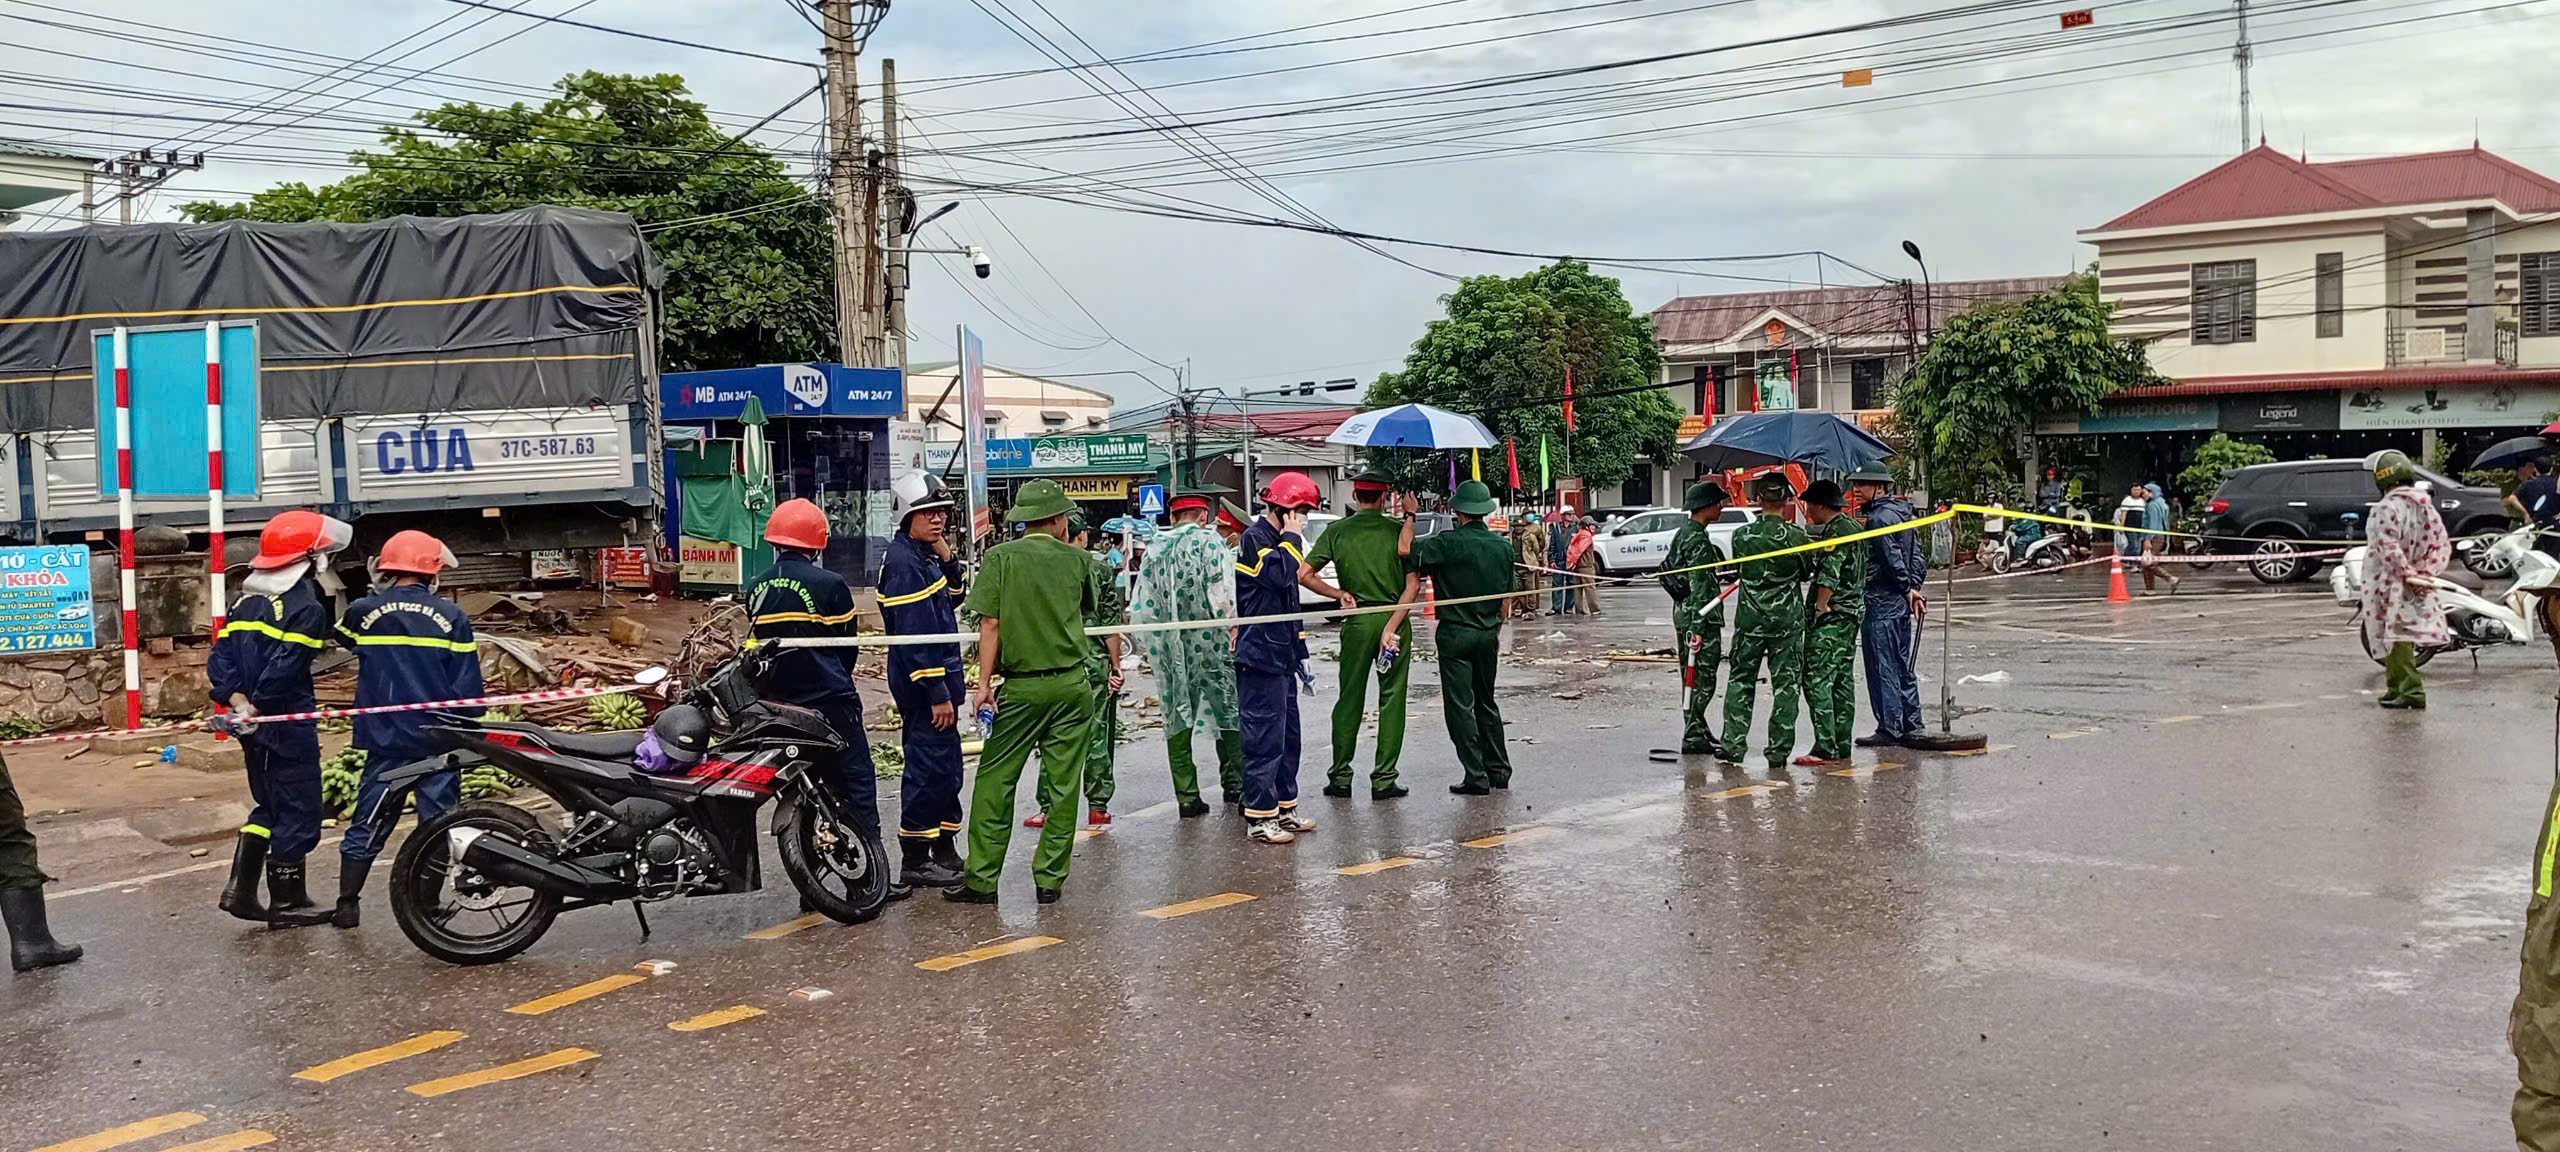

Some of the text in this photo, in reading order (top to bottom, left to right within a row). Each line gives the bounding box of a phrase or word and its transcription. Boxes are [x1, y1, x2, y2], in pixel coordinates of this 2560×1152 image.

[793, 375, 823, 393] ATM
[695, 386, 715, 403] MB
[717, 391, 735, 402] ATM
[847, 390, 893, 401] ATM 24/7
[2259, 407, 2298, 420] Legend
[500, 437, 596, 458] 37C-587.63
[927, 449, 951, 458] THANH
[1089, 443, 1126, 456] THANH
[985, 448, 1023, 462] obifone
[682, 546, 716, 563] BÁNH
[379, 602, 398, 615] SÁT
[397, 601, 423, 613] PCCC
[0, 632, 85, 651] 2.127.444
[730, 788, 755, 798] YAMAHA
